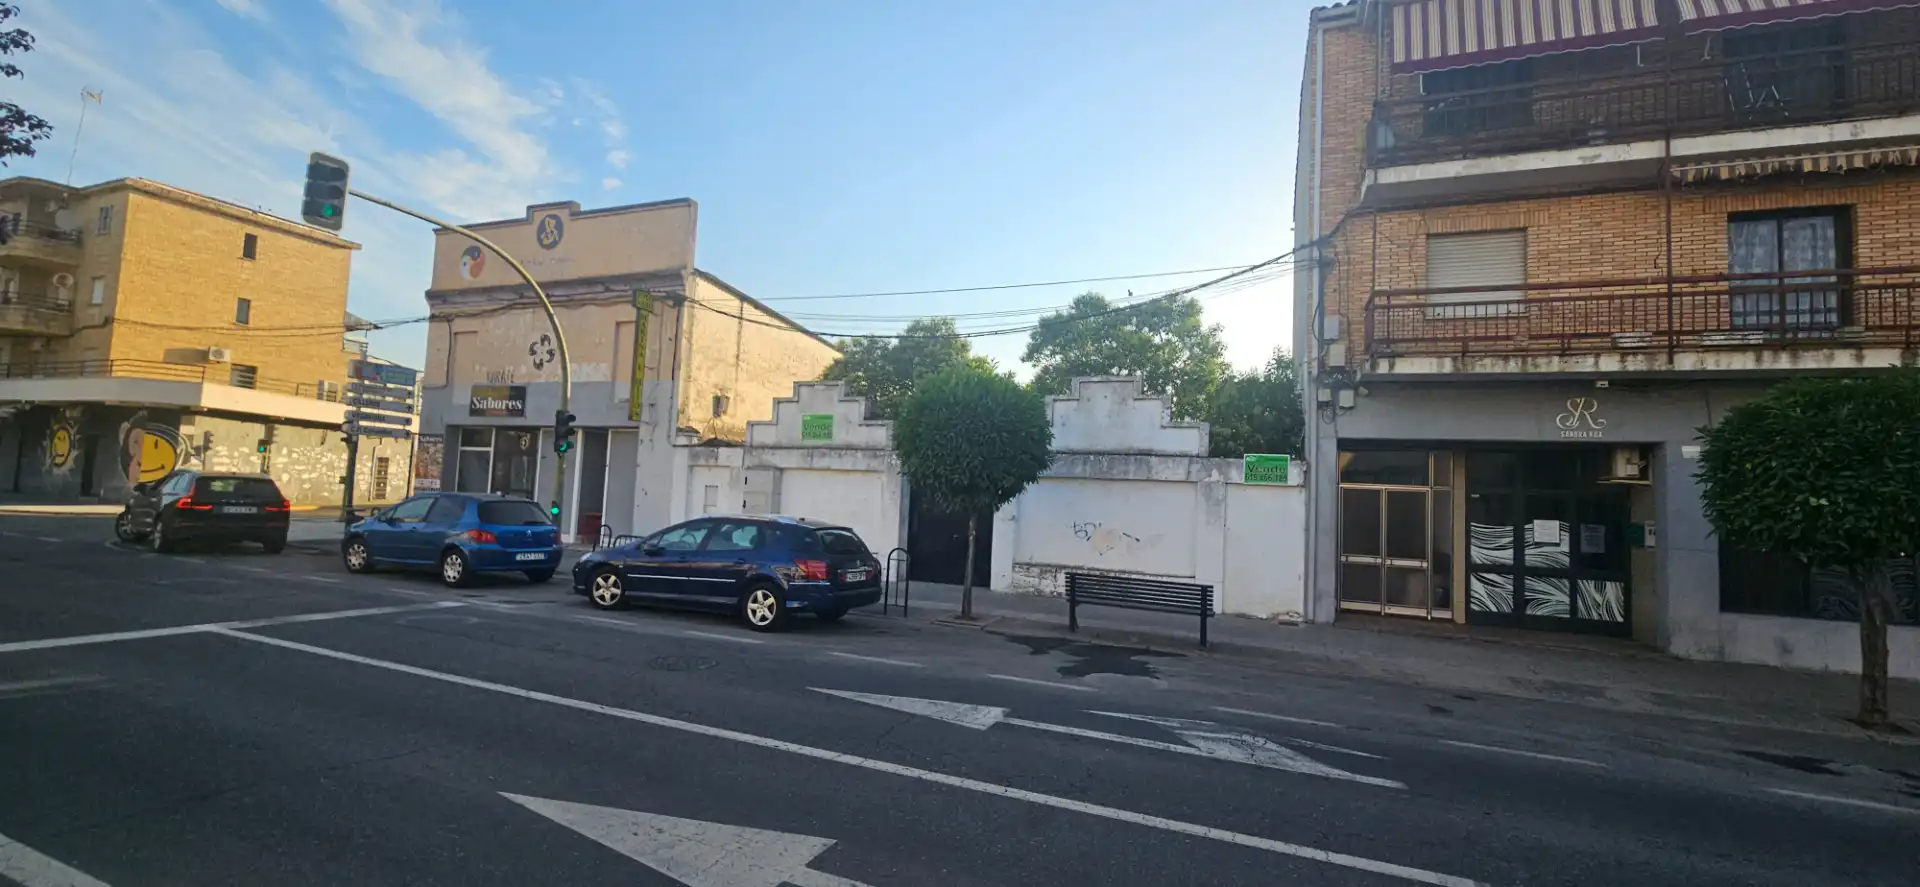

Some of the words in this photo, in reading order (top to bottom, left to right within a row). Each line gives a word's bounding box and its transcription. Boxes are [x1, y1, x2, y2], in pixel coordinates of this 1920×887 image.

[471, 396, 523, 410] Sabores
[803, 423, 833, 431] Vende
[1560, 430, 1587, 438] SANDRA
[1247, 464, 1286, 473] Vende
